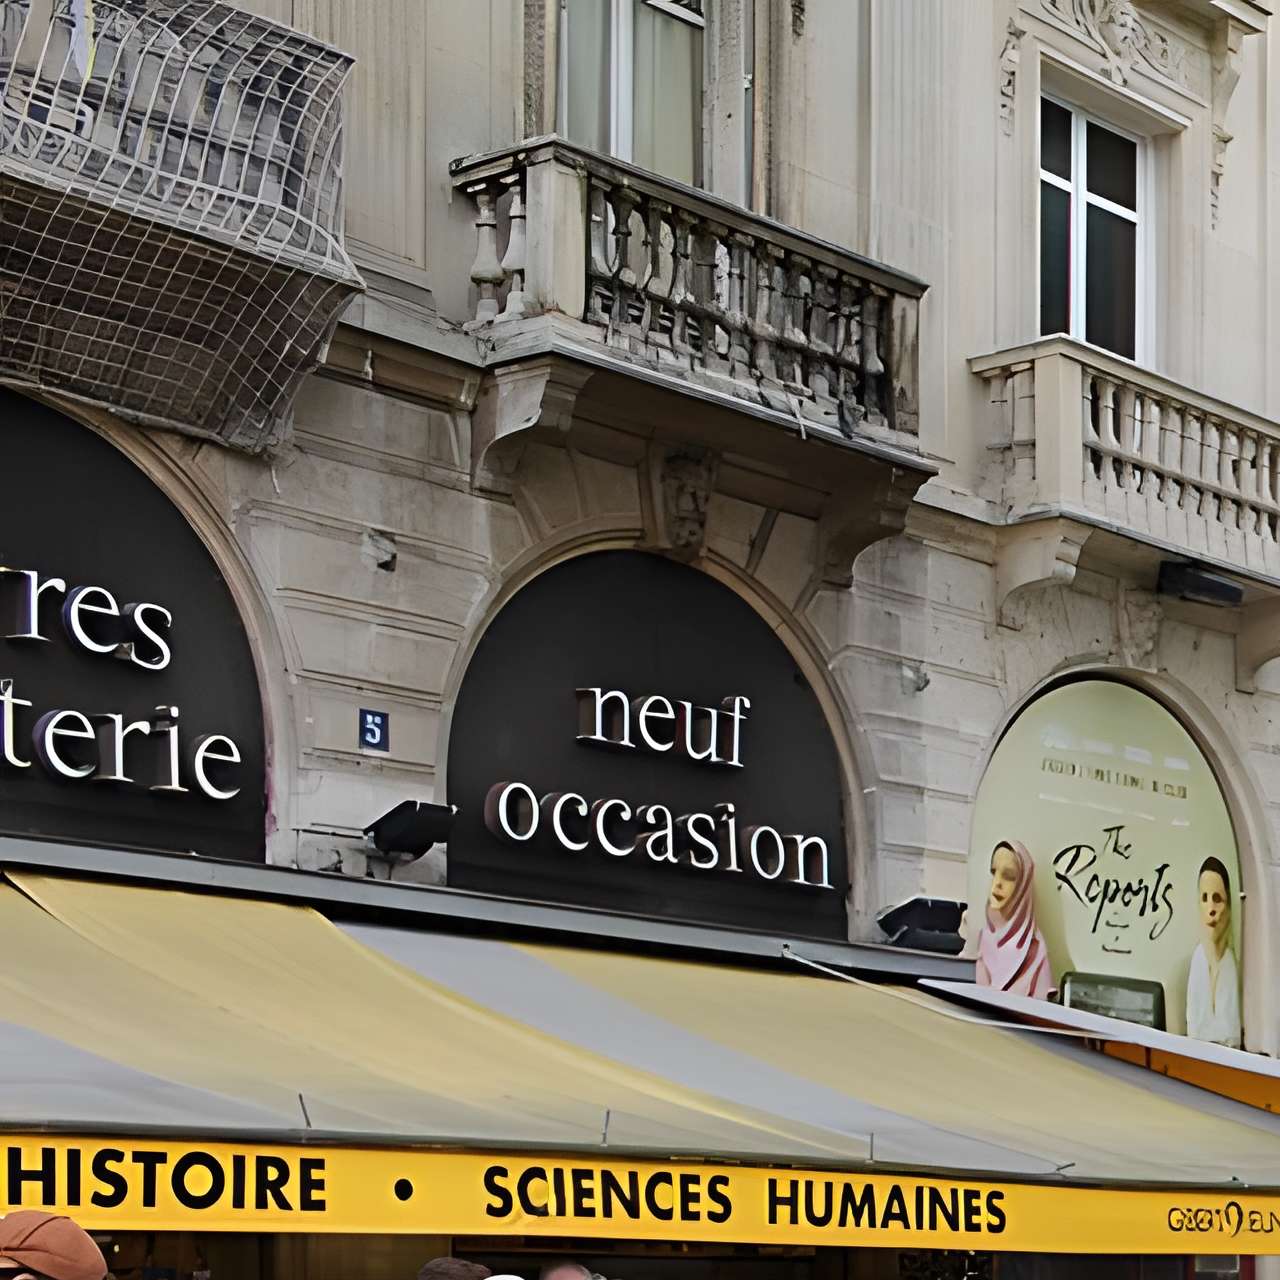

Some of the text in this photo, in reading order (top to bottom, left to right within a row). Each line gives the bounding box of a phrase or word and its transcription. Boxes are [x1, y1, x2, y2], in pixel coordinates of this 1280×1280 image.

[365, 714, 382, 744] 5
[580, 687, 750, 767] neuf
[492, 781, 834, 888] occasion
[6, 1147, 327, 1211] HISTOIRE
[483, 1165, 732, 1224] SCIENCES
[767, 1178, 1007, 1234] HUMAINES
